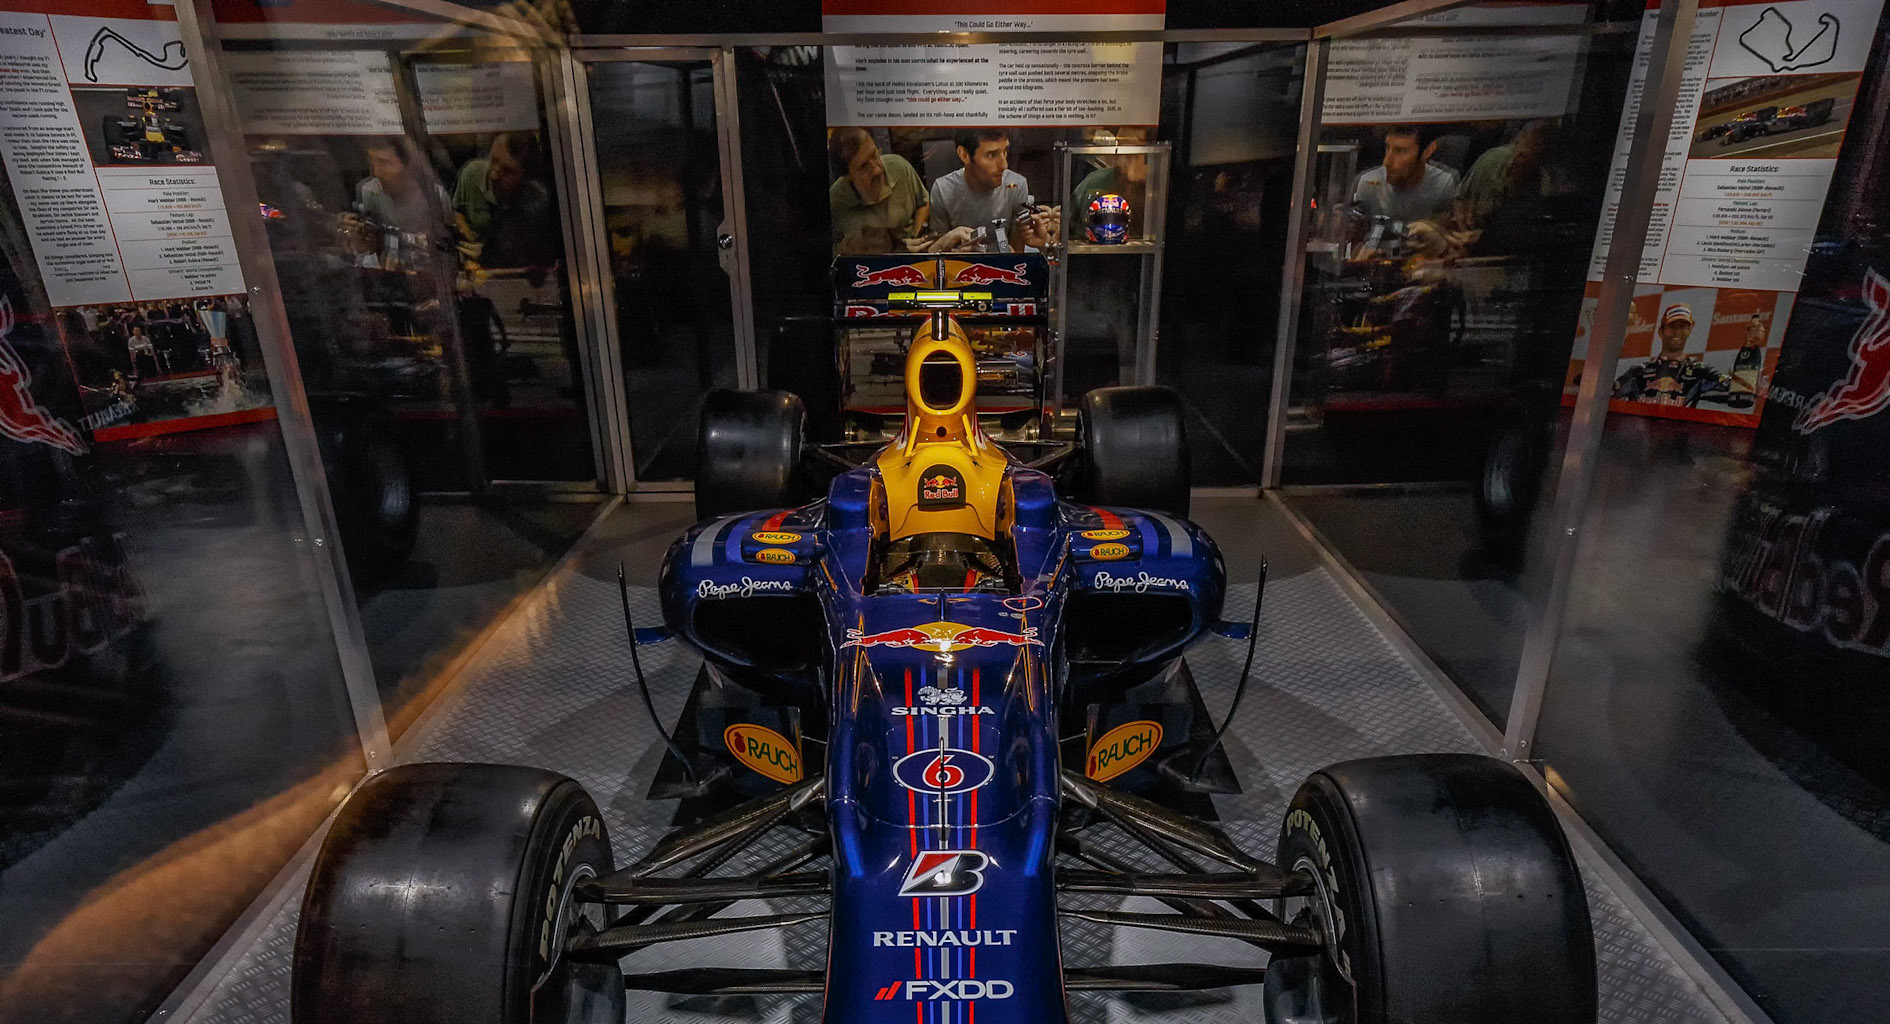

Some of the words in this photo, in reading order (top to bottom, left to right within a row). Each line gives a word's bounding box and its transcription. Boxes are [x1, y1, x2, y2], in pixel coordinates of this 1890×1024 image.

[969, 20, 985, 28] Could
[986, 20, 994, 28] Go
[995, 20, 1013, 28] Either
[924, 489, 941, 499] Red
[941, 488, 958, 498] Bull
[766, 554, 791, 562] RAUCH
[1101, 548, 1125, 556] RAUCH
[697, 580, 741, 599] Pepe
[741, 577, 792, 598] Jeans
[1094, 572, 1137, 592] Pepe
[1135, 572, 1189, 593] Jeans
[891, 706, 995, 716] SINGHA
[747, 735, 798, 778] RAUCH
[1096, 731, 1154, 770] RAUCH
[922, 754, 964, 788] 6
[873, 930, 1018, 947] RENAULT
[906, 980, 1014, 1000] FXDD
